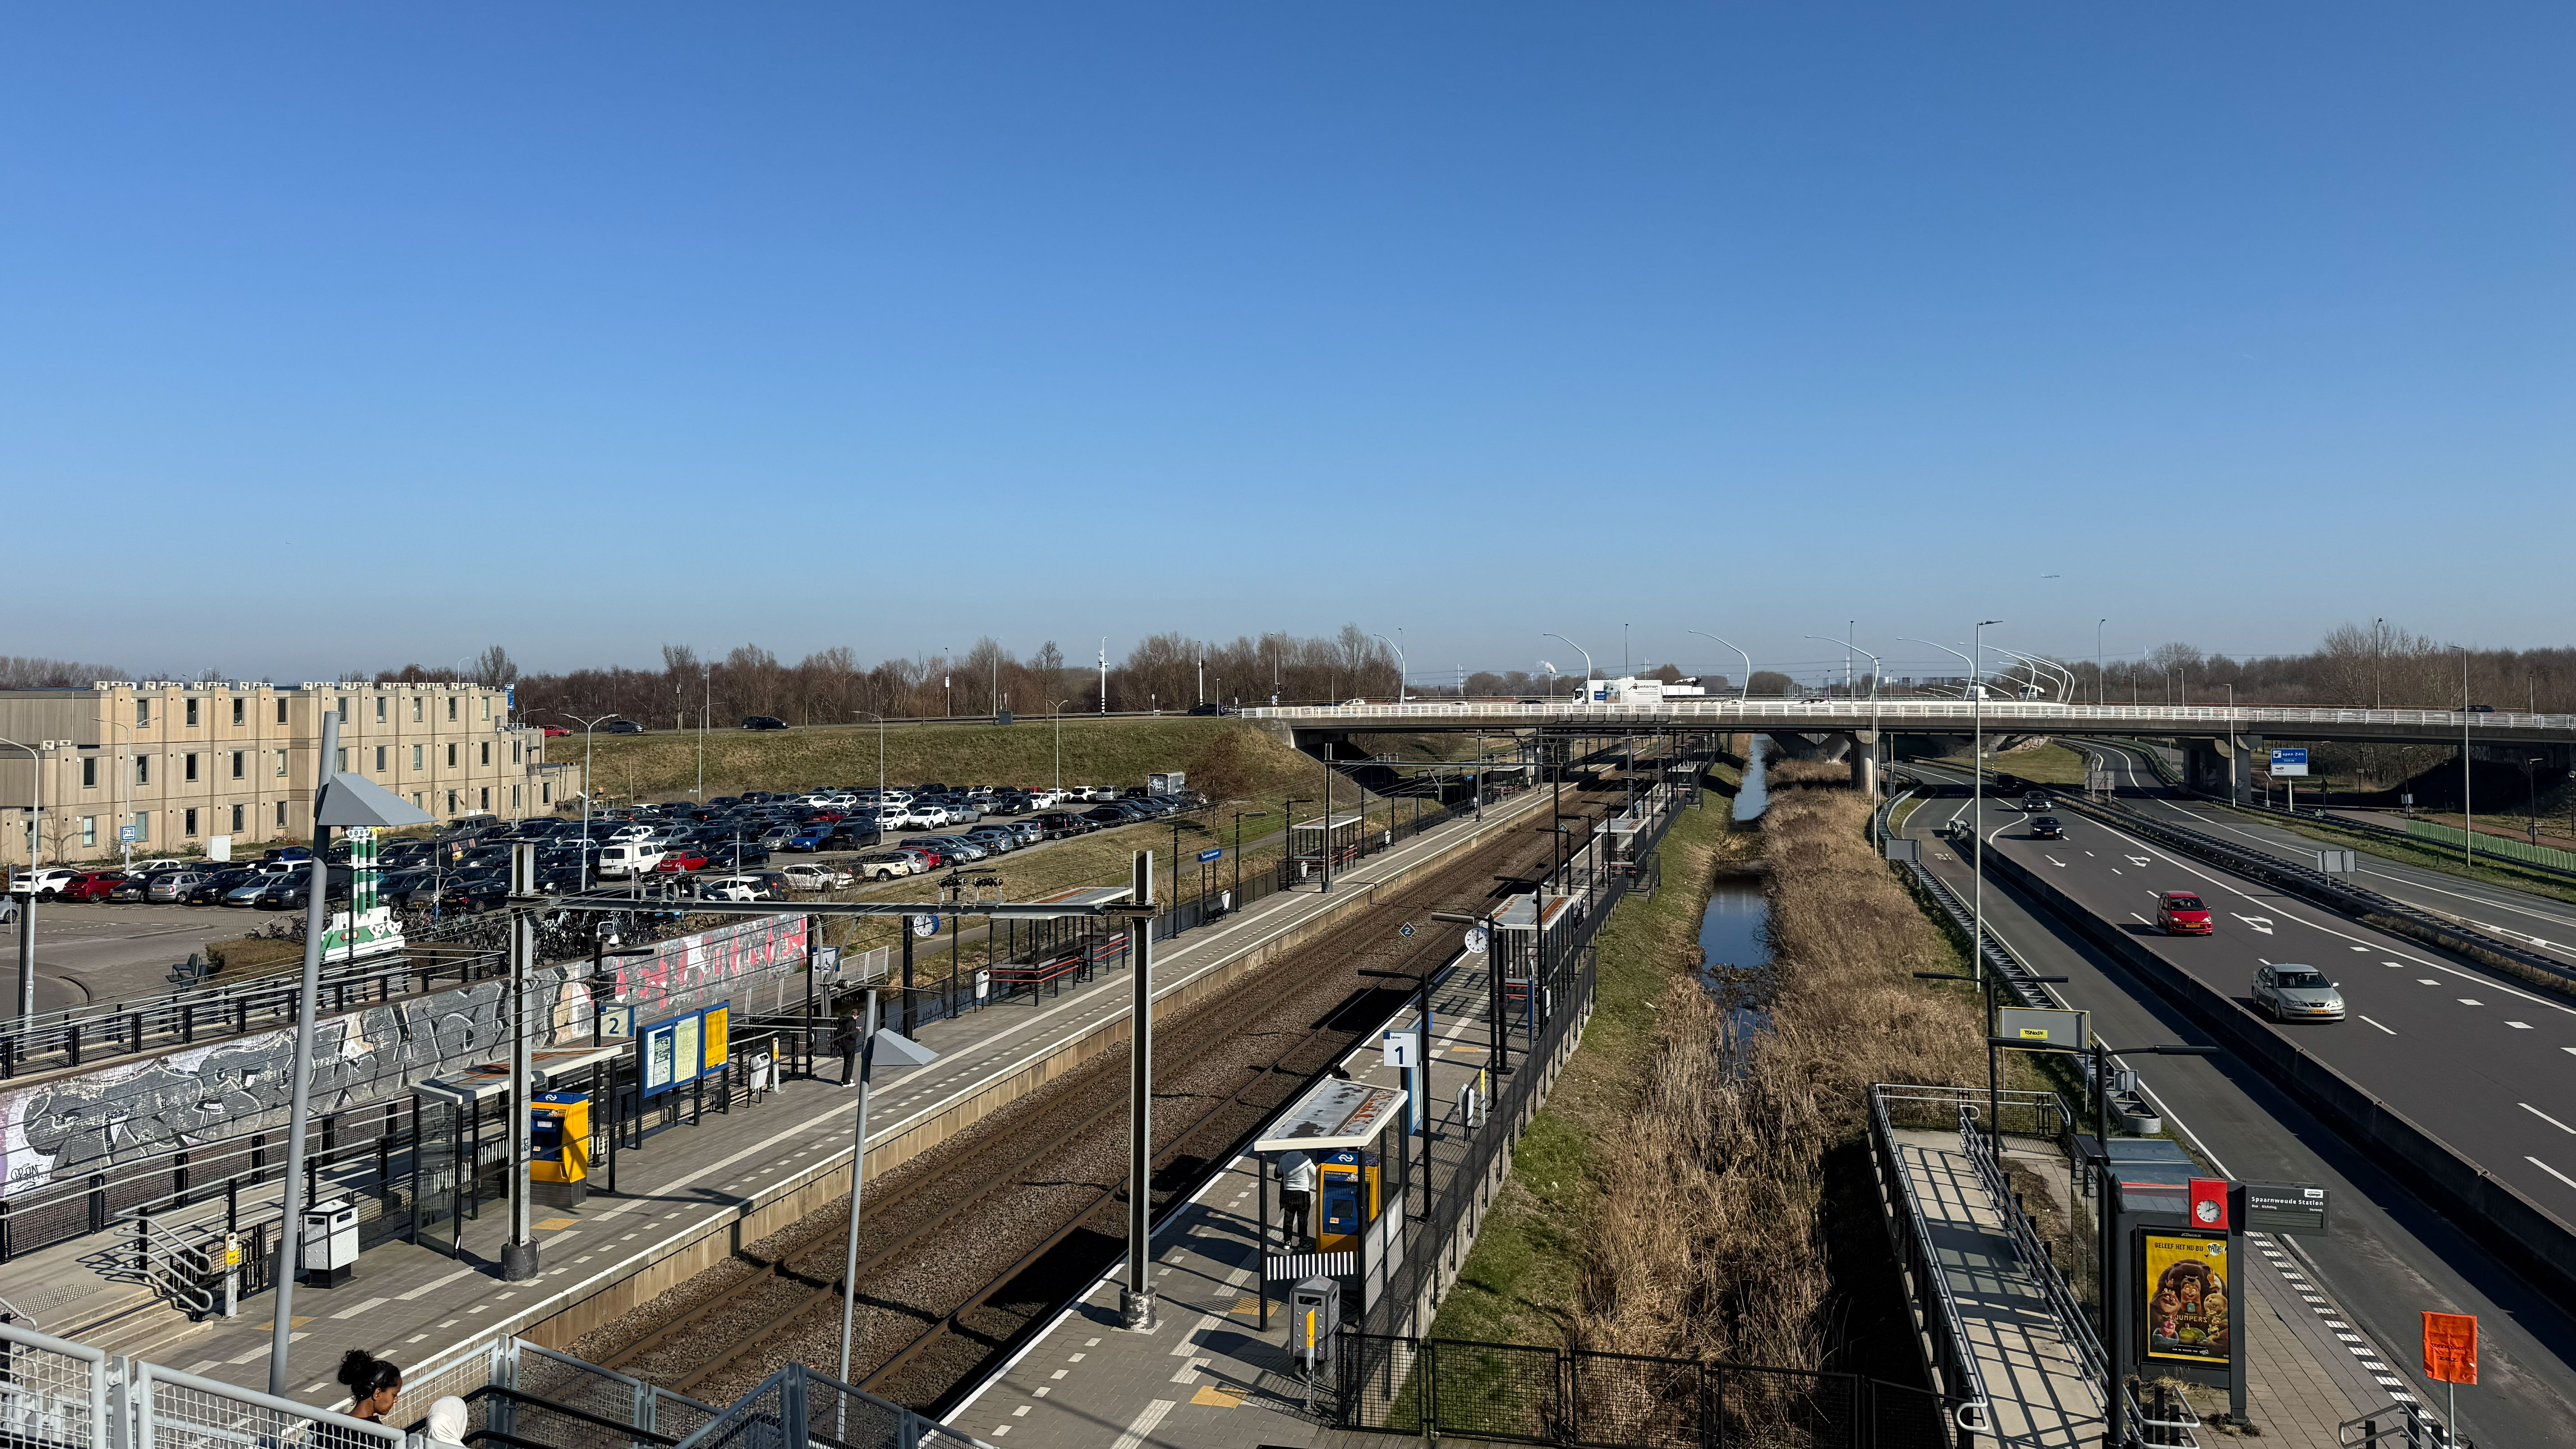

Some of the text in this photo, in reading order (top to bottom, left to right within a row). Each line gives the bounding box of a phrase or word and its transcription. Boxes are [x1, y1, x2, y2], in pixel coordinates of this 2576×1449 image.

[609, 1017, 619, 1034] 2
[1394, 1046, 1403, 1064] 1
[2251, 1196, 2297, 1205] Spaarnwoude
[2175, 1315, 2208, 1323] JUMPERS
